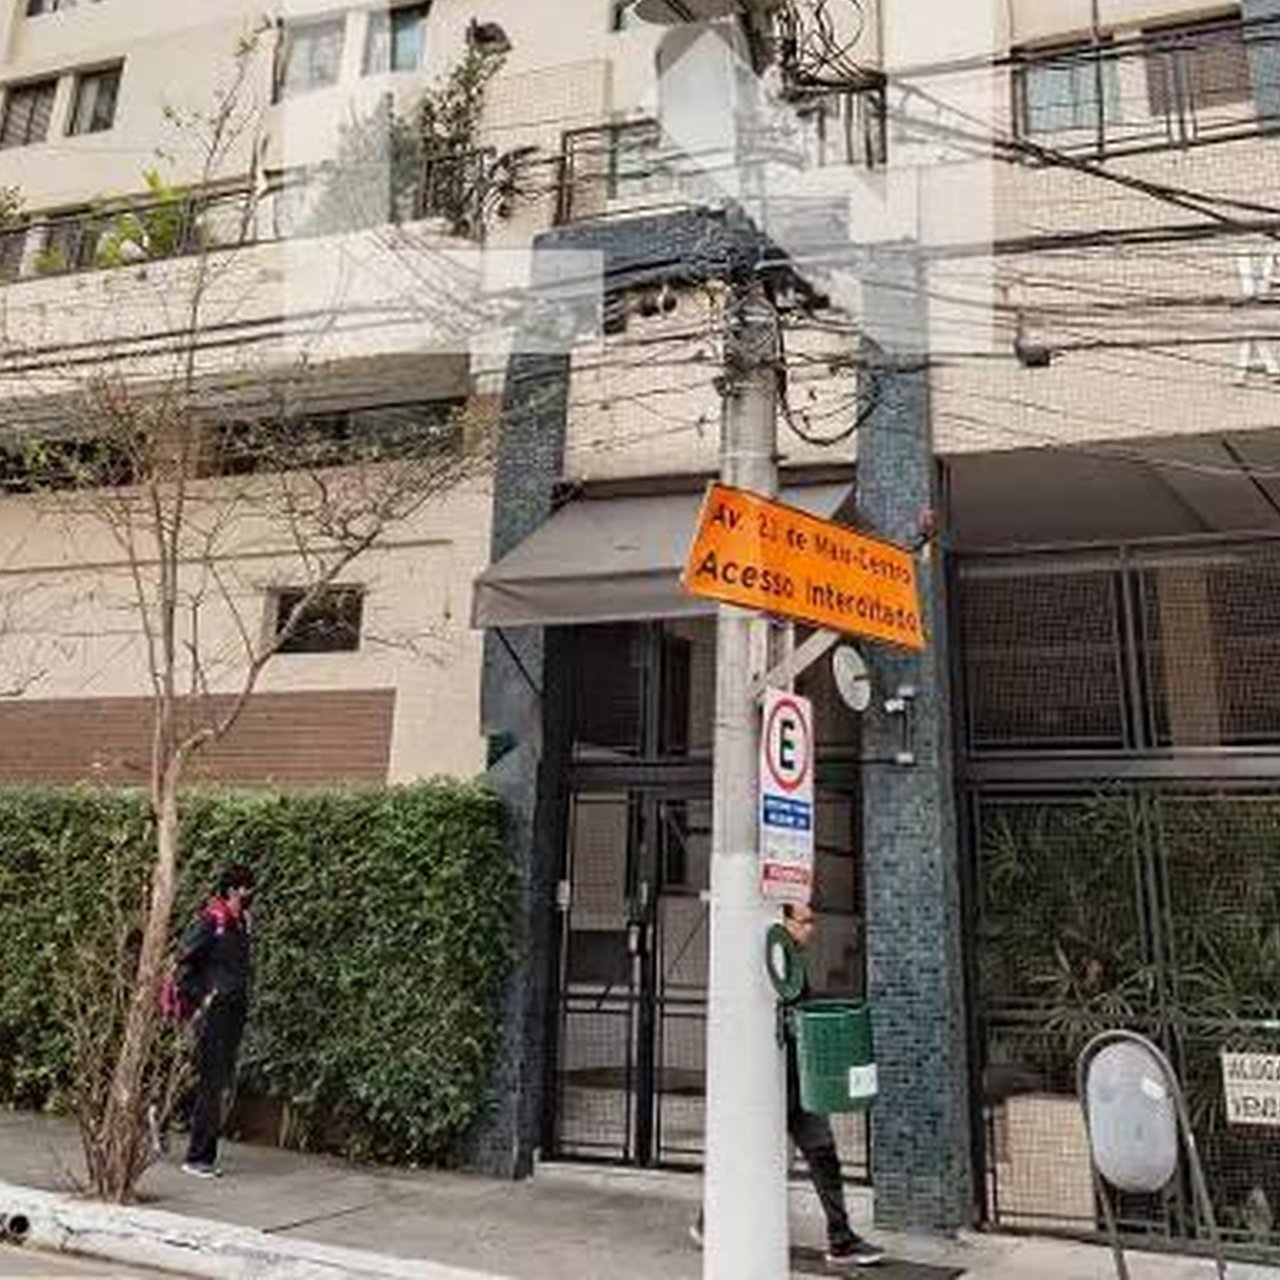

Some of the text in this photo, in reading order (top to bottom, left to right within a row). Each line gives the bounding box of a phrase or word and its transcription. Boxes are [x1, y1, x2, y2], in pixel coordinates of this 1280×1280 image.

[710, 503, 744, 533] Av.
[696, 550, 918, 632] Acesso Interditado
[779, 720, 795, 770] E
